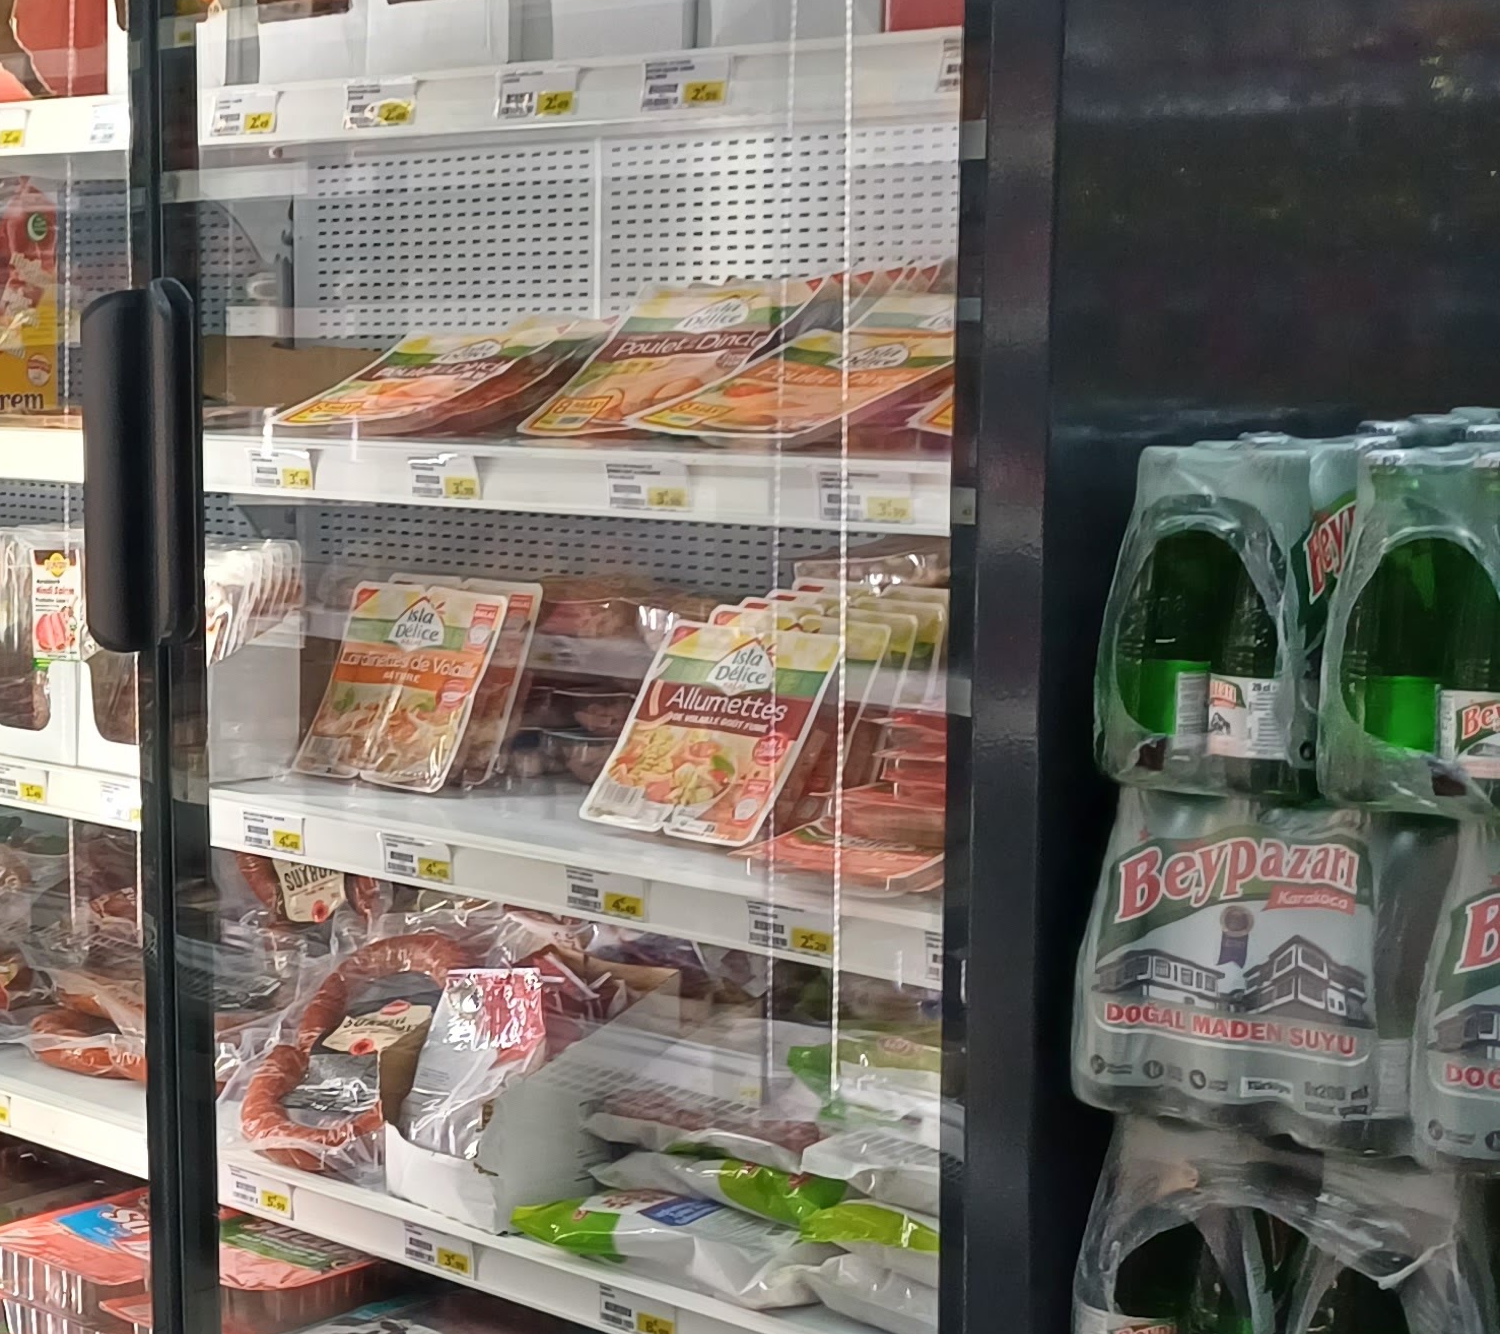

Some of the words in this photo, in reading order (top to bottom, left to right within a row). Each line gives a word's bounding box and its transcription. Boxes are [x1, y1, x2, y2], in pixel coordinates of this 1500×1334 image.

[612, 337, 688, 358] Poulet
[407, 609, 435, 624] Isla
[395, 623, 440, 642] Délice
[731, 649, 763, 667] Isla
[714, 665, 767, 685] Délice
[665, 685, 789, 722] Allumettes
[1114, 836, 1359, 924] Beypazarı
[1192, 1014, 1282, 1043] MADEN
[1288, 1027, 1356, 1057] SUYU
